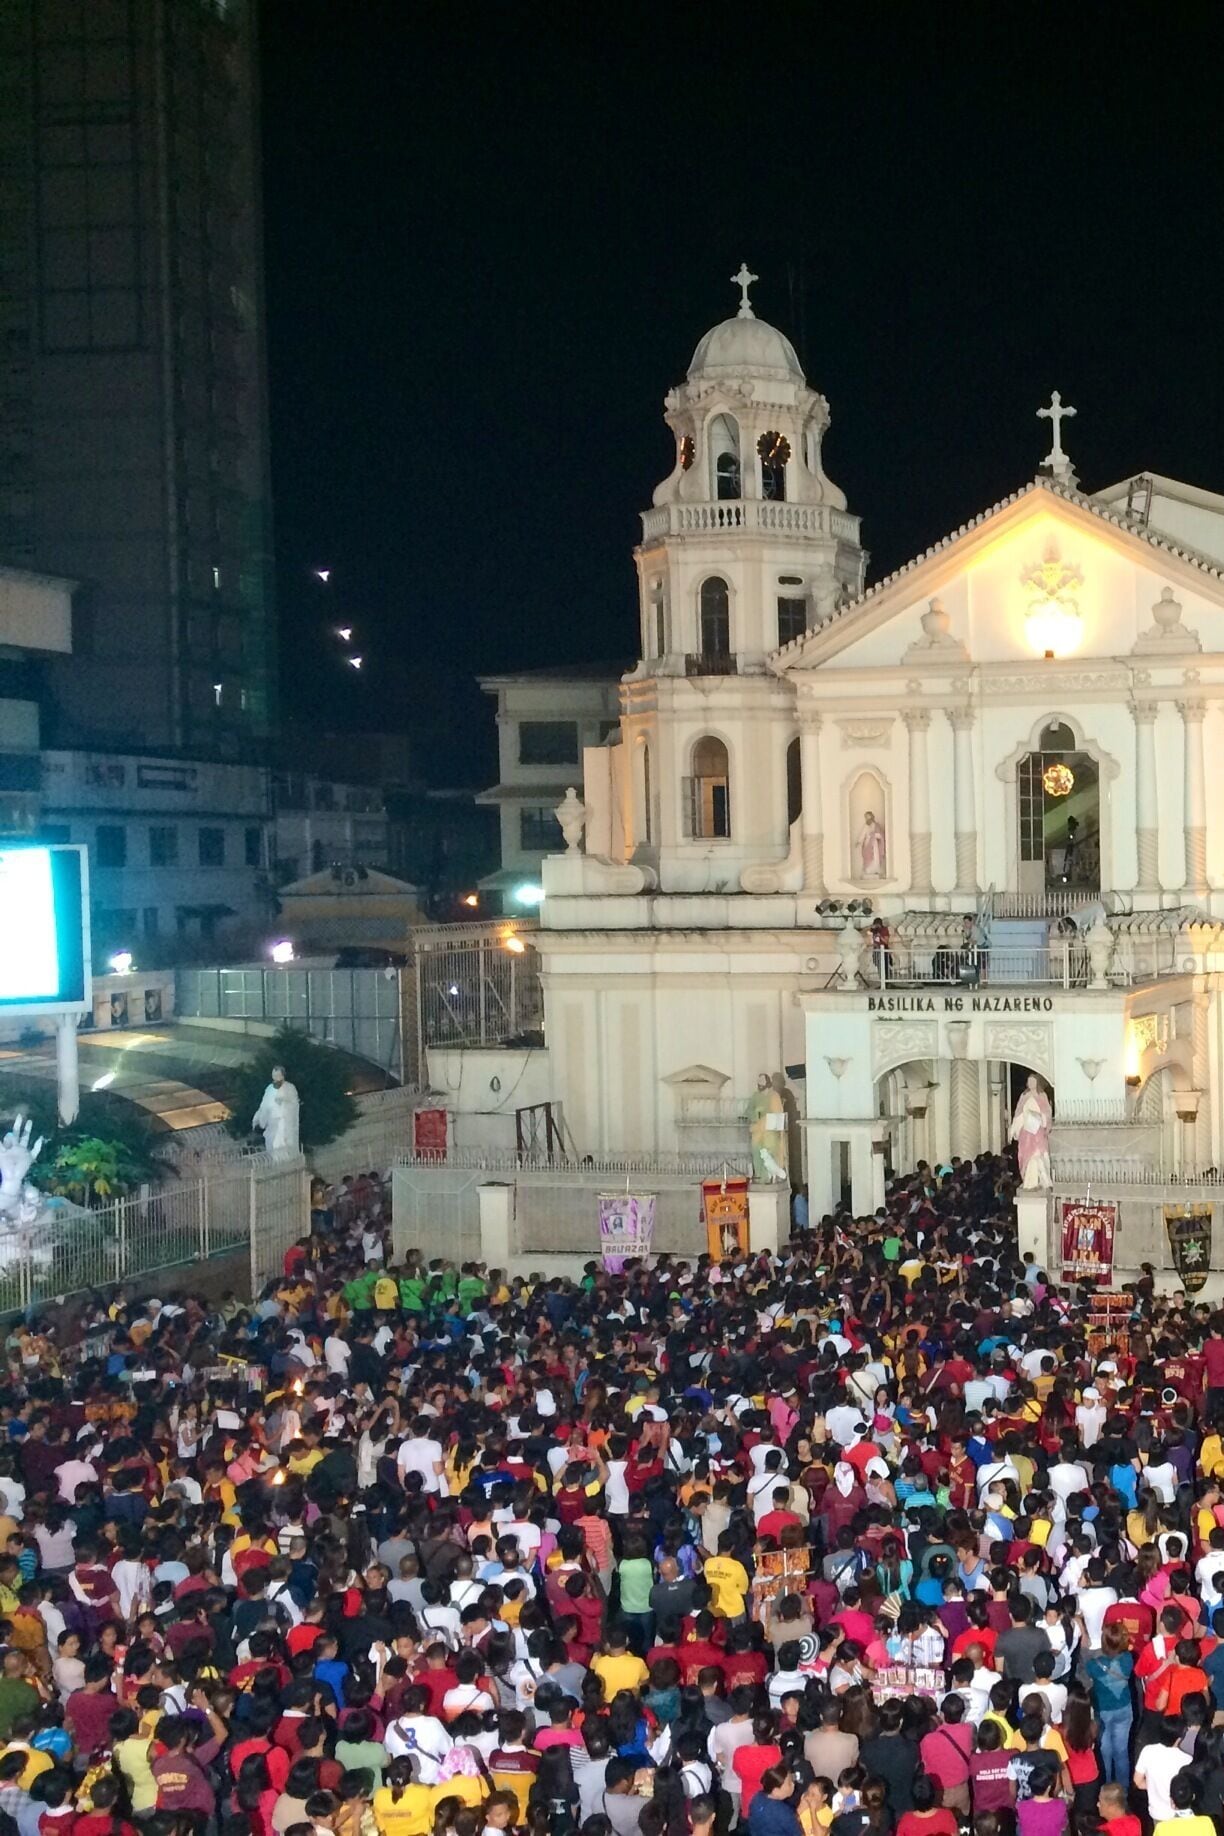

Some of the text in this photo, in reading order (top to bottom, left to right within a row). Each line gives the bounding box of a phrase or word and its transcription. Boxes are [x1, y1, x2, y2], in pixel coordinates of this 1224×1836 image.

[868, 997, 1053, 1011] BASILIKA NG NAZARENO
